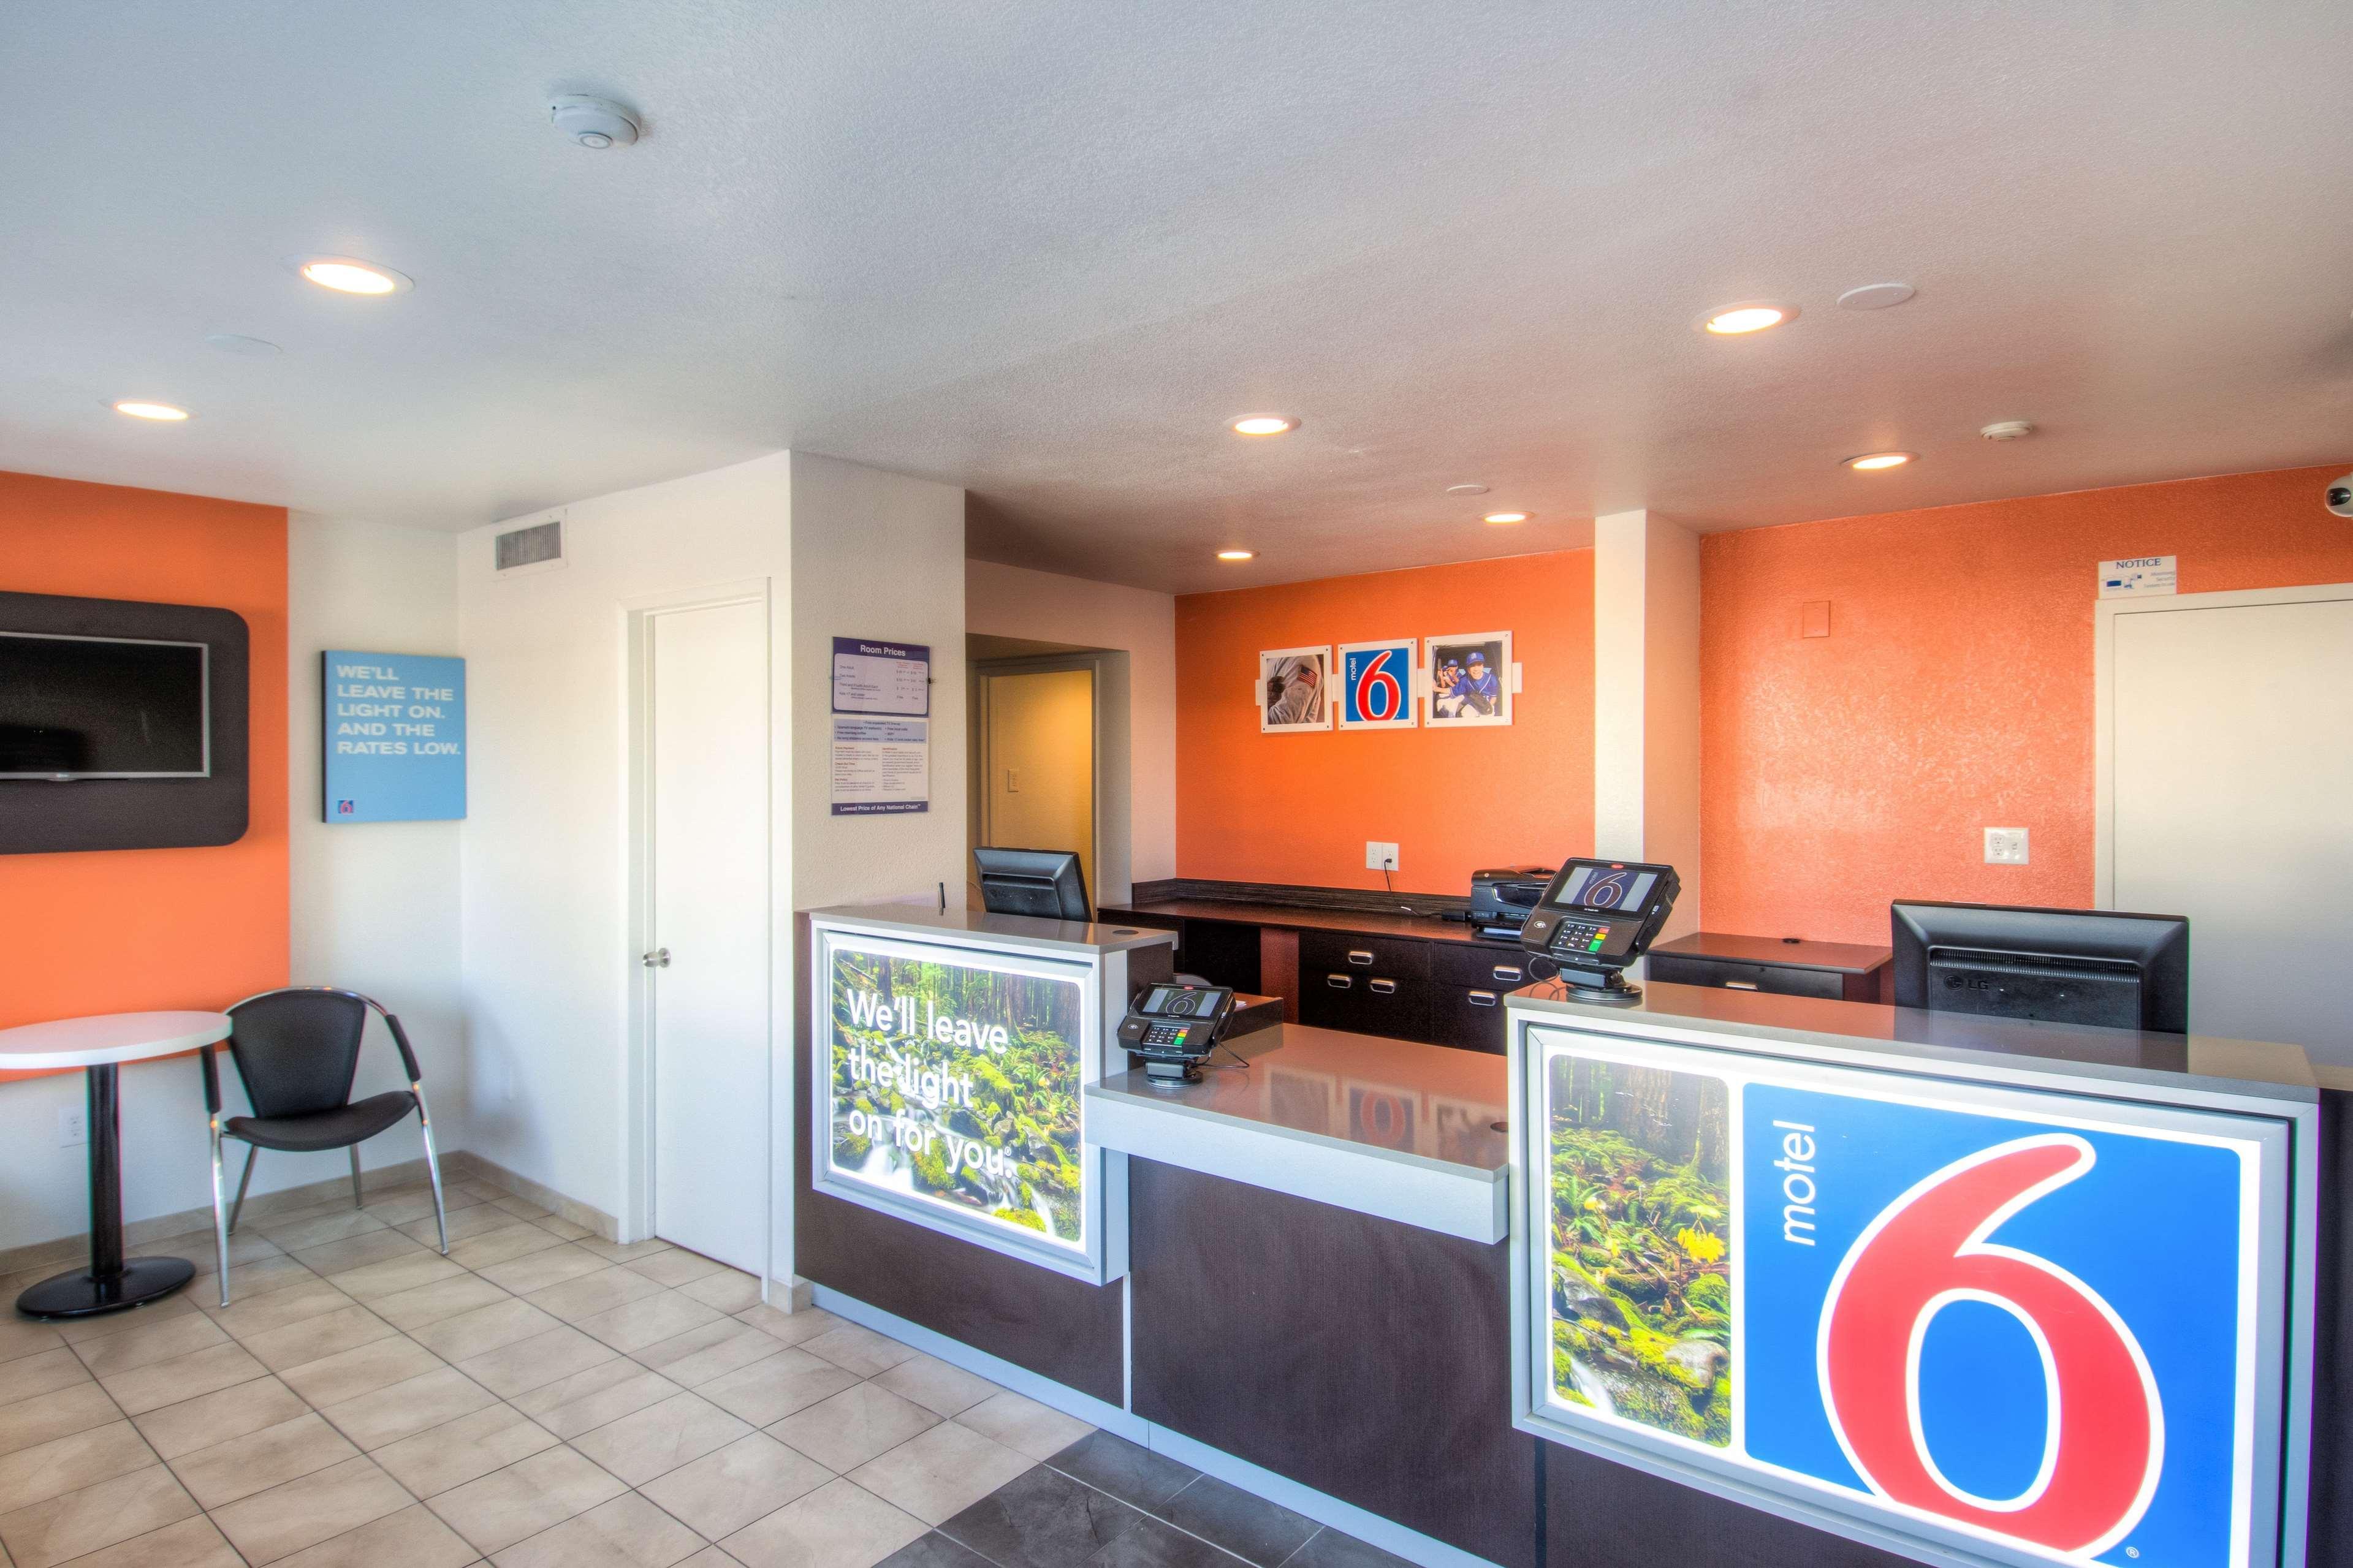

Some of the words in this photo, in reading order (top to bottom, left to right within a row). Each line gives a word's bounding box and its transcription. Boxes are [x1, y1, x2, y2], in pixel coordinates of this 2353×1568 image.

[2116, 558, 2161, 569] NOTICE
[860, 645, 882, 654] Room
[884, 647, 906, 656] Prices
[336, 665, 399, 680] WE'LL
[337, 684, 406, 700] LEAVE
[412, 687, 454, 701] THE
[1356, 650, 1401, 721] 6
[337, 703, 403, 718] LIGHT
[408, 705, 446, 719] ON.
[338, 722, 386, 736] AND
[392, 724, 435, 737] THE
[338, 741, 408, 755] RATES
[414, 743, 461, 755] LOW.
[1584, 873, 1627, 908] 6
[1968, 980, 1989, 991] LG
[1166, 992, 1196, 1015] 6
[847, 988, 915, 1036] We'll
[927, 1000, 1008, 1055] leave
[848, 1044, 894, 1088] the
[905, 1053, 973, 1110] light
[850, 1110, 883, 1142] on
[893, 1108, 936, 1156] for
[1773, 1119, 1816, 1246] motel
[1817, 1133, 2165, 1561] 6
